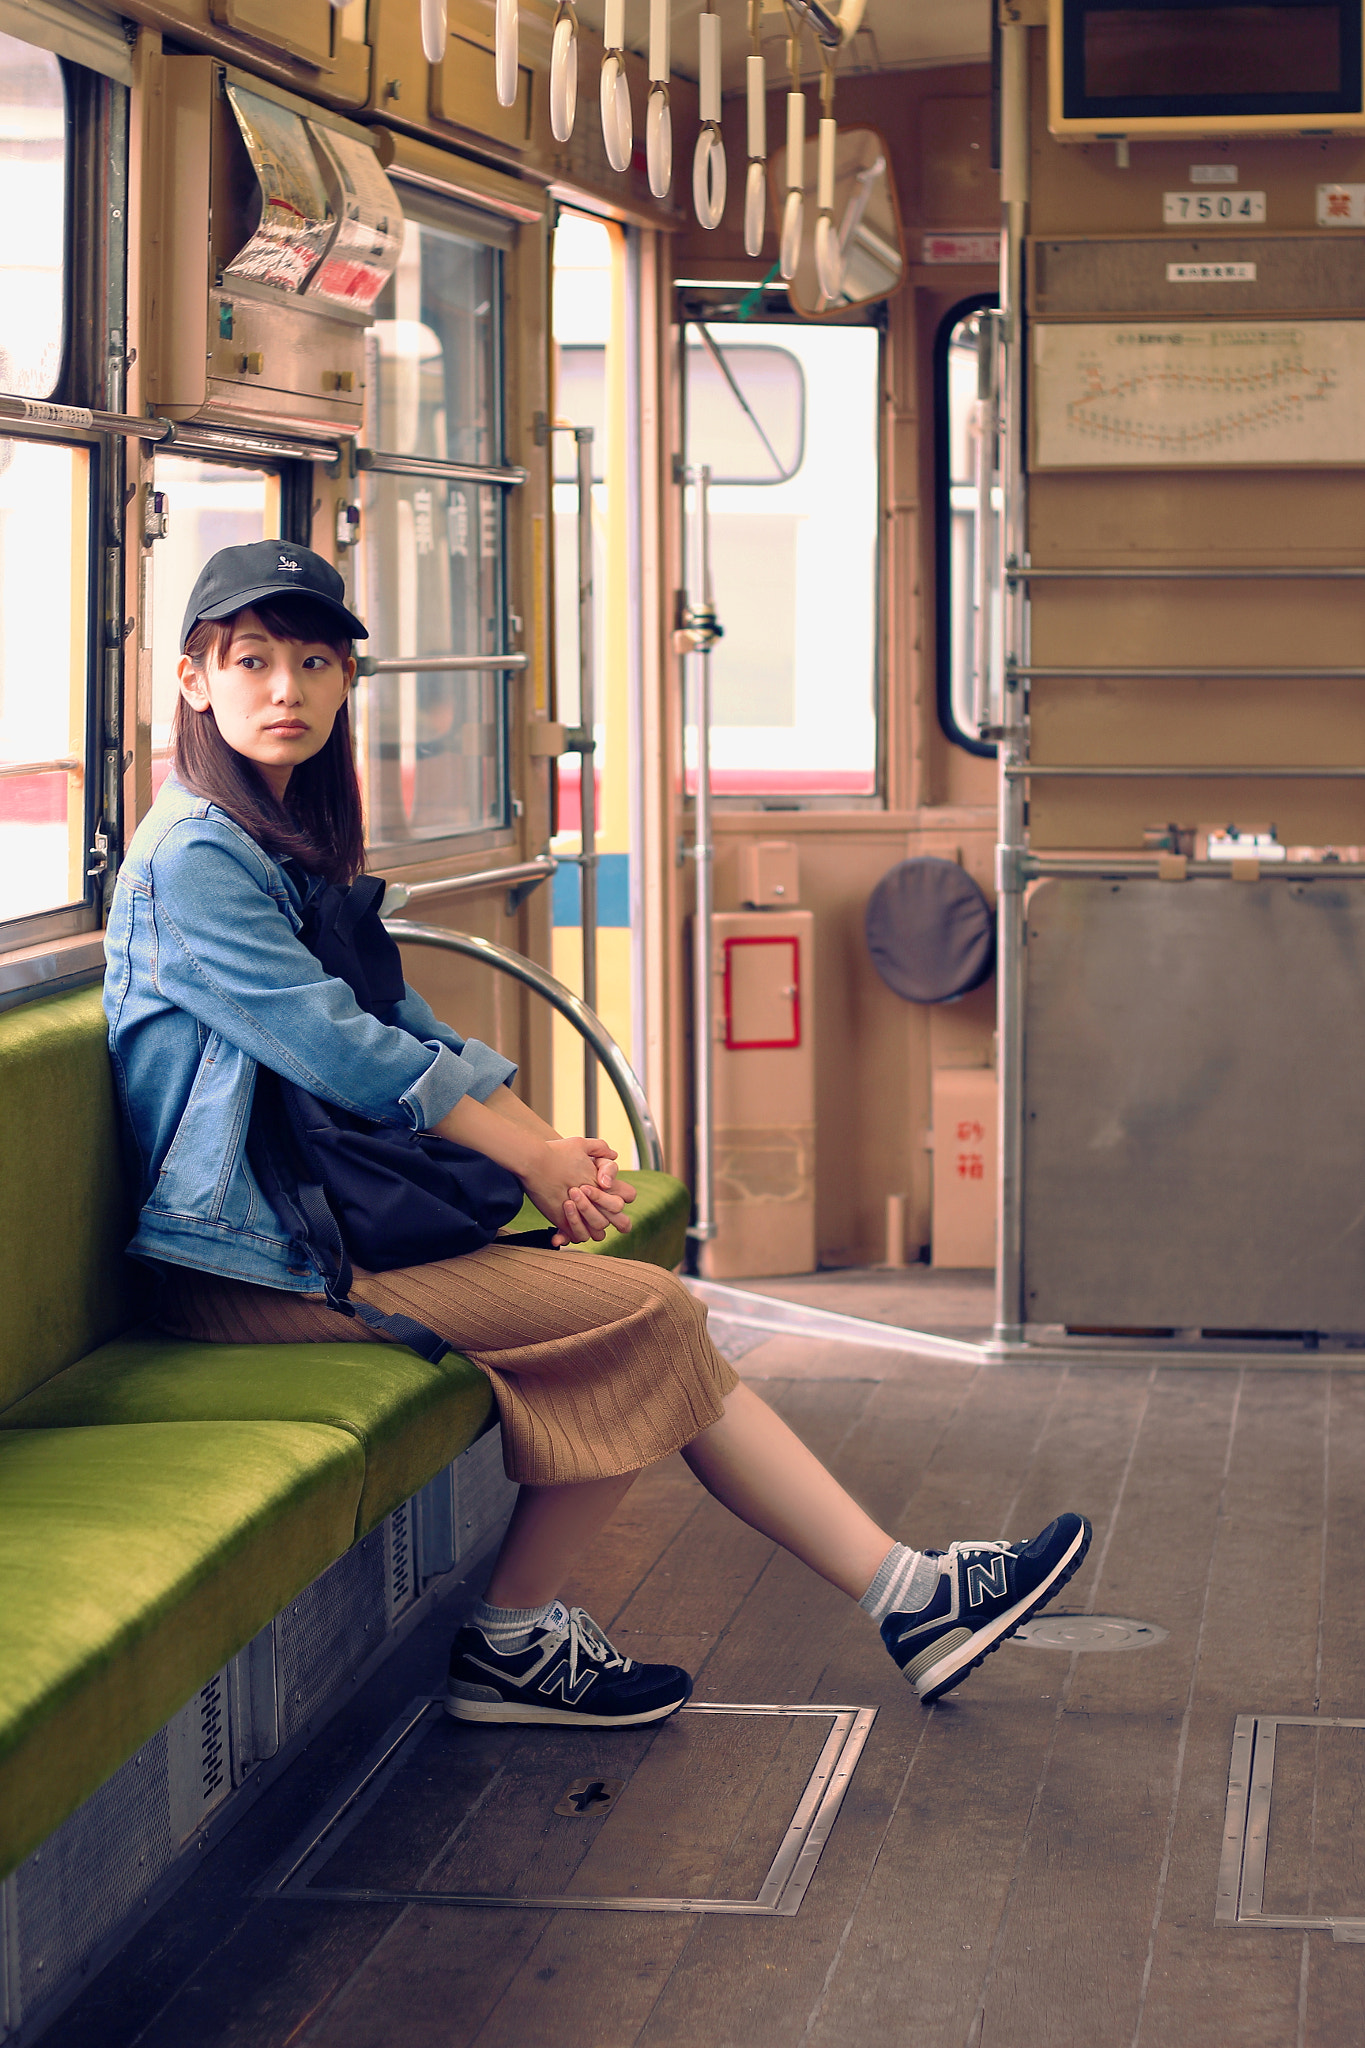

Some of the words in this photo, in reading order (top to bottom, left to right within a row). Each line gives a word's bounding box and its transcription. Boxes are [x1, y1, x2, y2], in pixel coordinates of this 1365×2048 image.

[1177, 196, 1251, 218] 7504
[1327, 194, 1365, 217] 禁
[957, 1121, 983, 1179] 砂箱
[967, 1555, 1008, 1607] N
[538, 1659, 599, 1705] N
